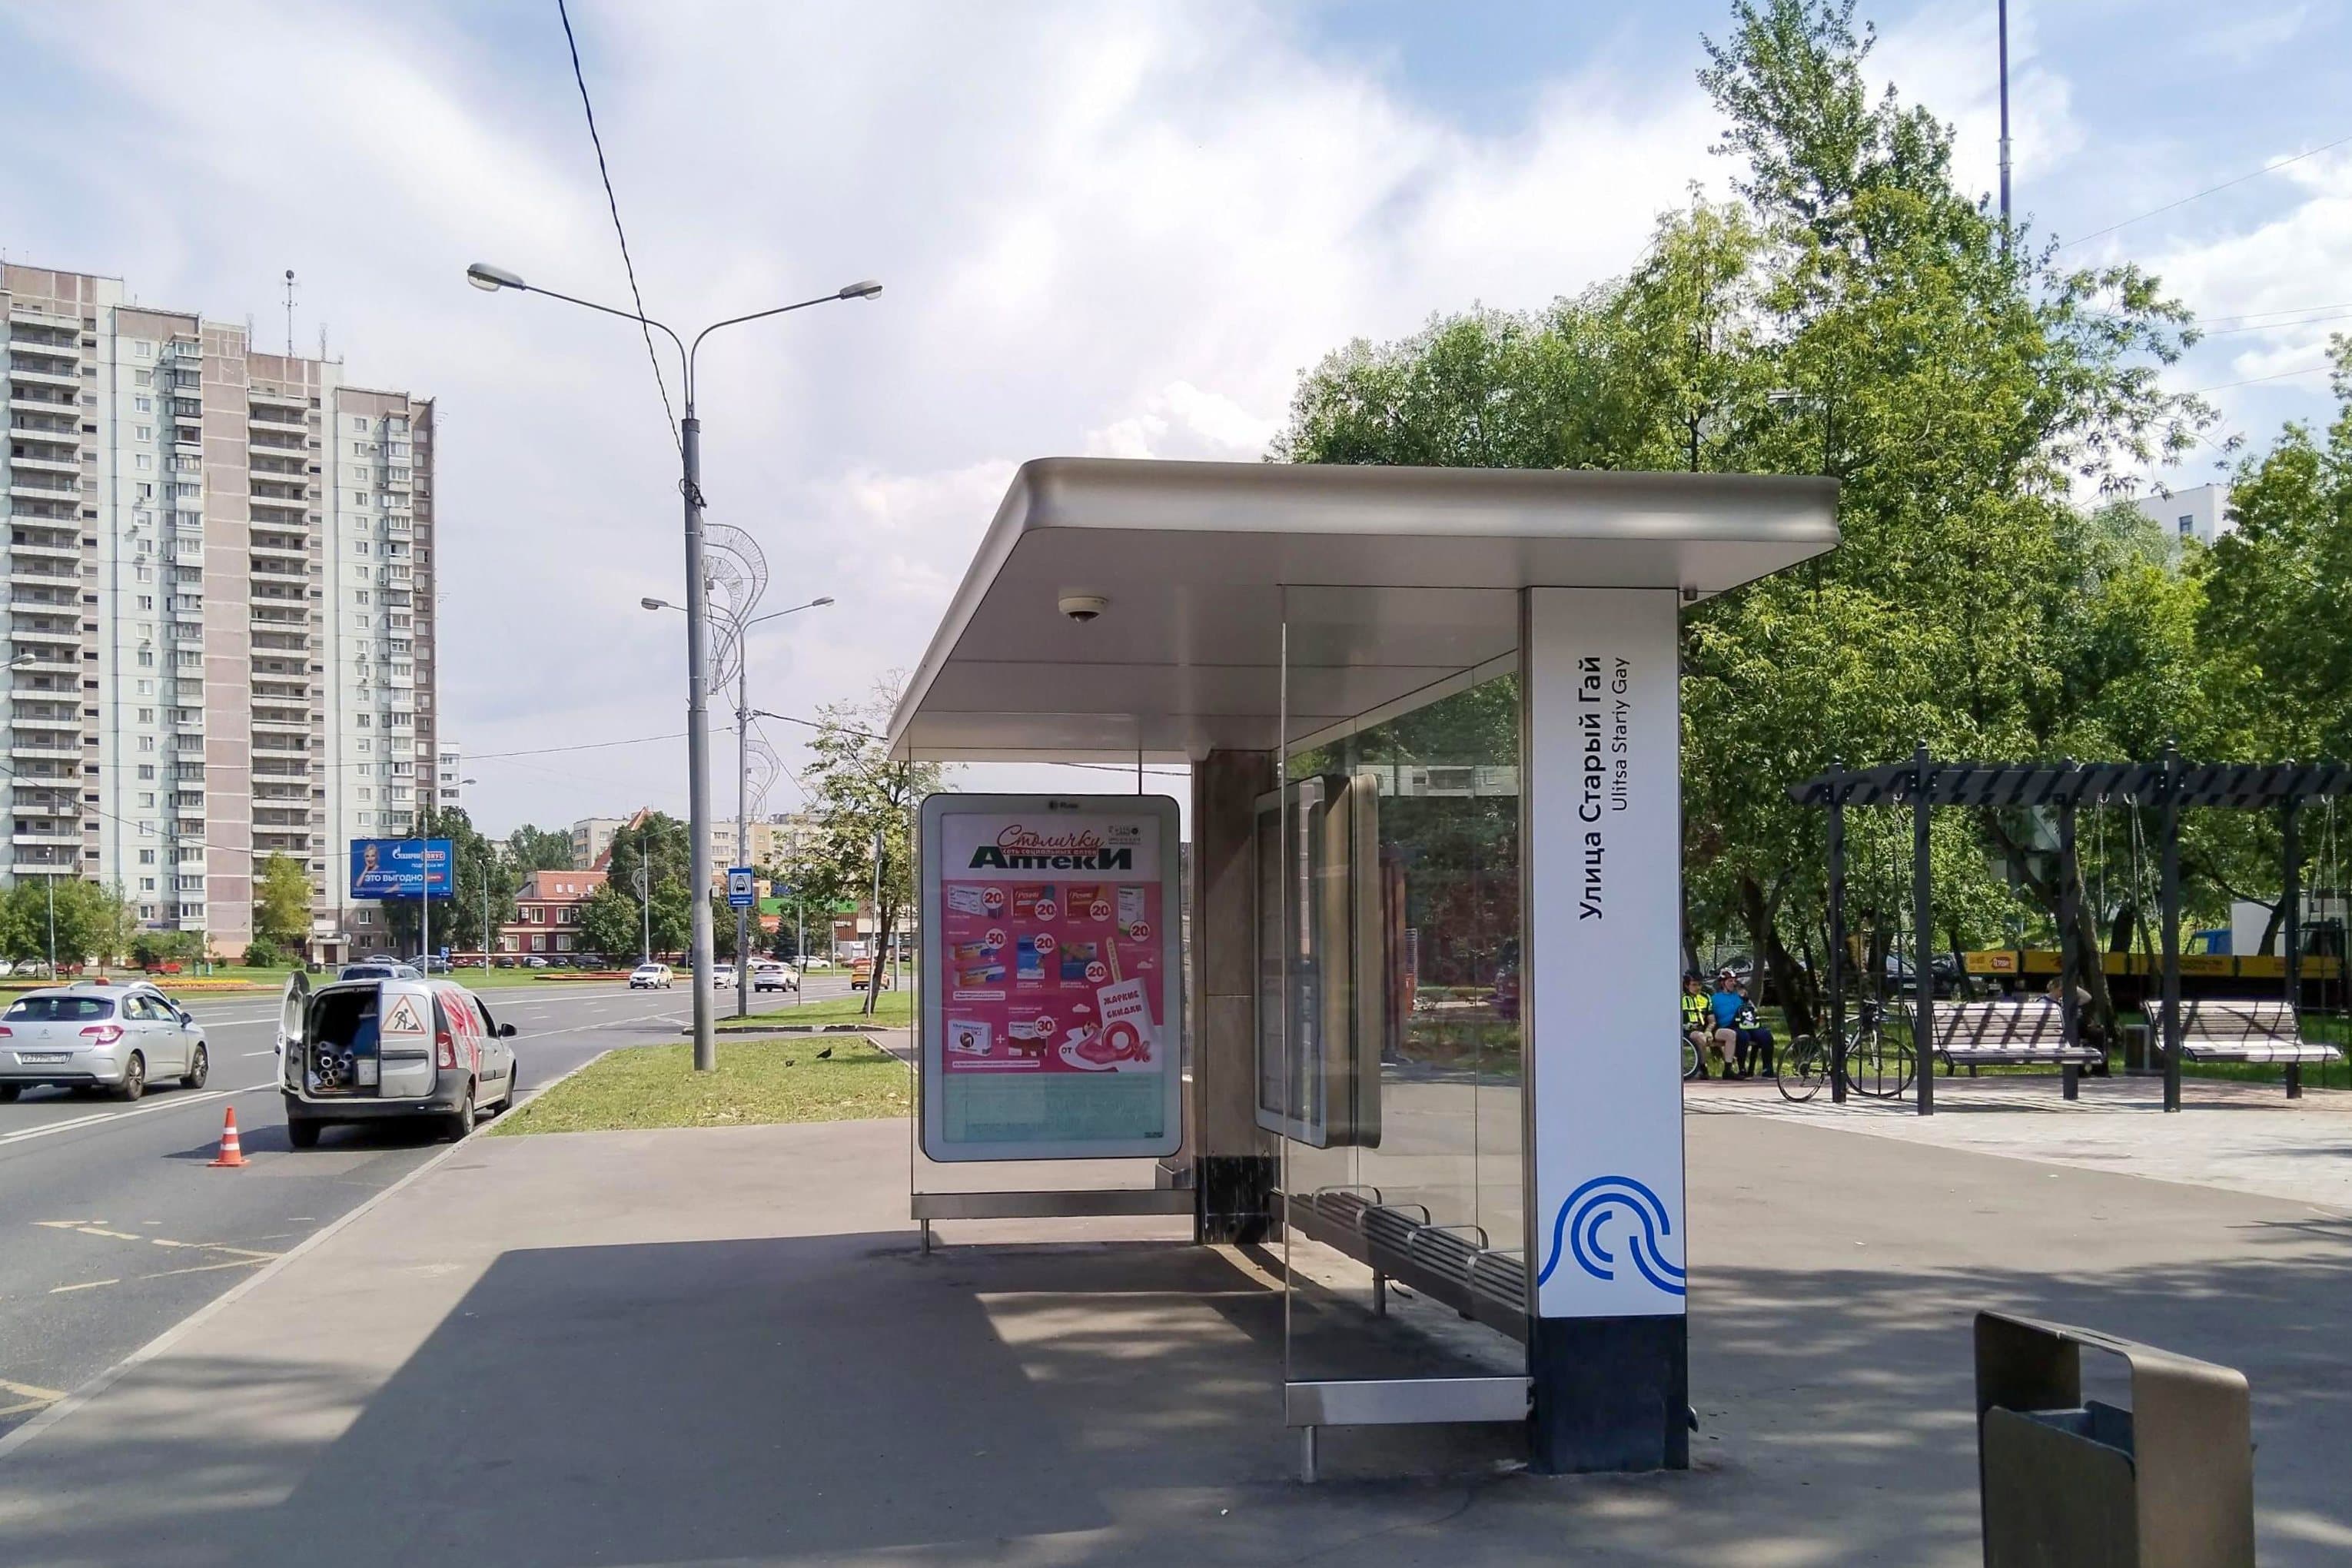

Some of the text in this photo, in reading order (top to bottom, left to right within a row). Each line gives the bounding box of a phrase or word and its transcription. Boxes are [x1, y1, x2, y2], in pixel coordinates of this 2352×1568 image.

[1611, 657, 1630, 811] Ulitsa Stariy Gay
[1578, 656, 1606, 920] Улица Старый Гай
[997, 825, 1105, 847] Столички
[1104, 991, 1139, 1005] ЖАРКИЕ
[1107, 1005, 1142, 1018] СКИДКИ
